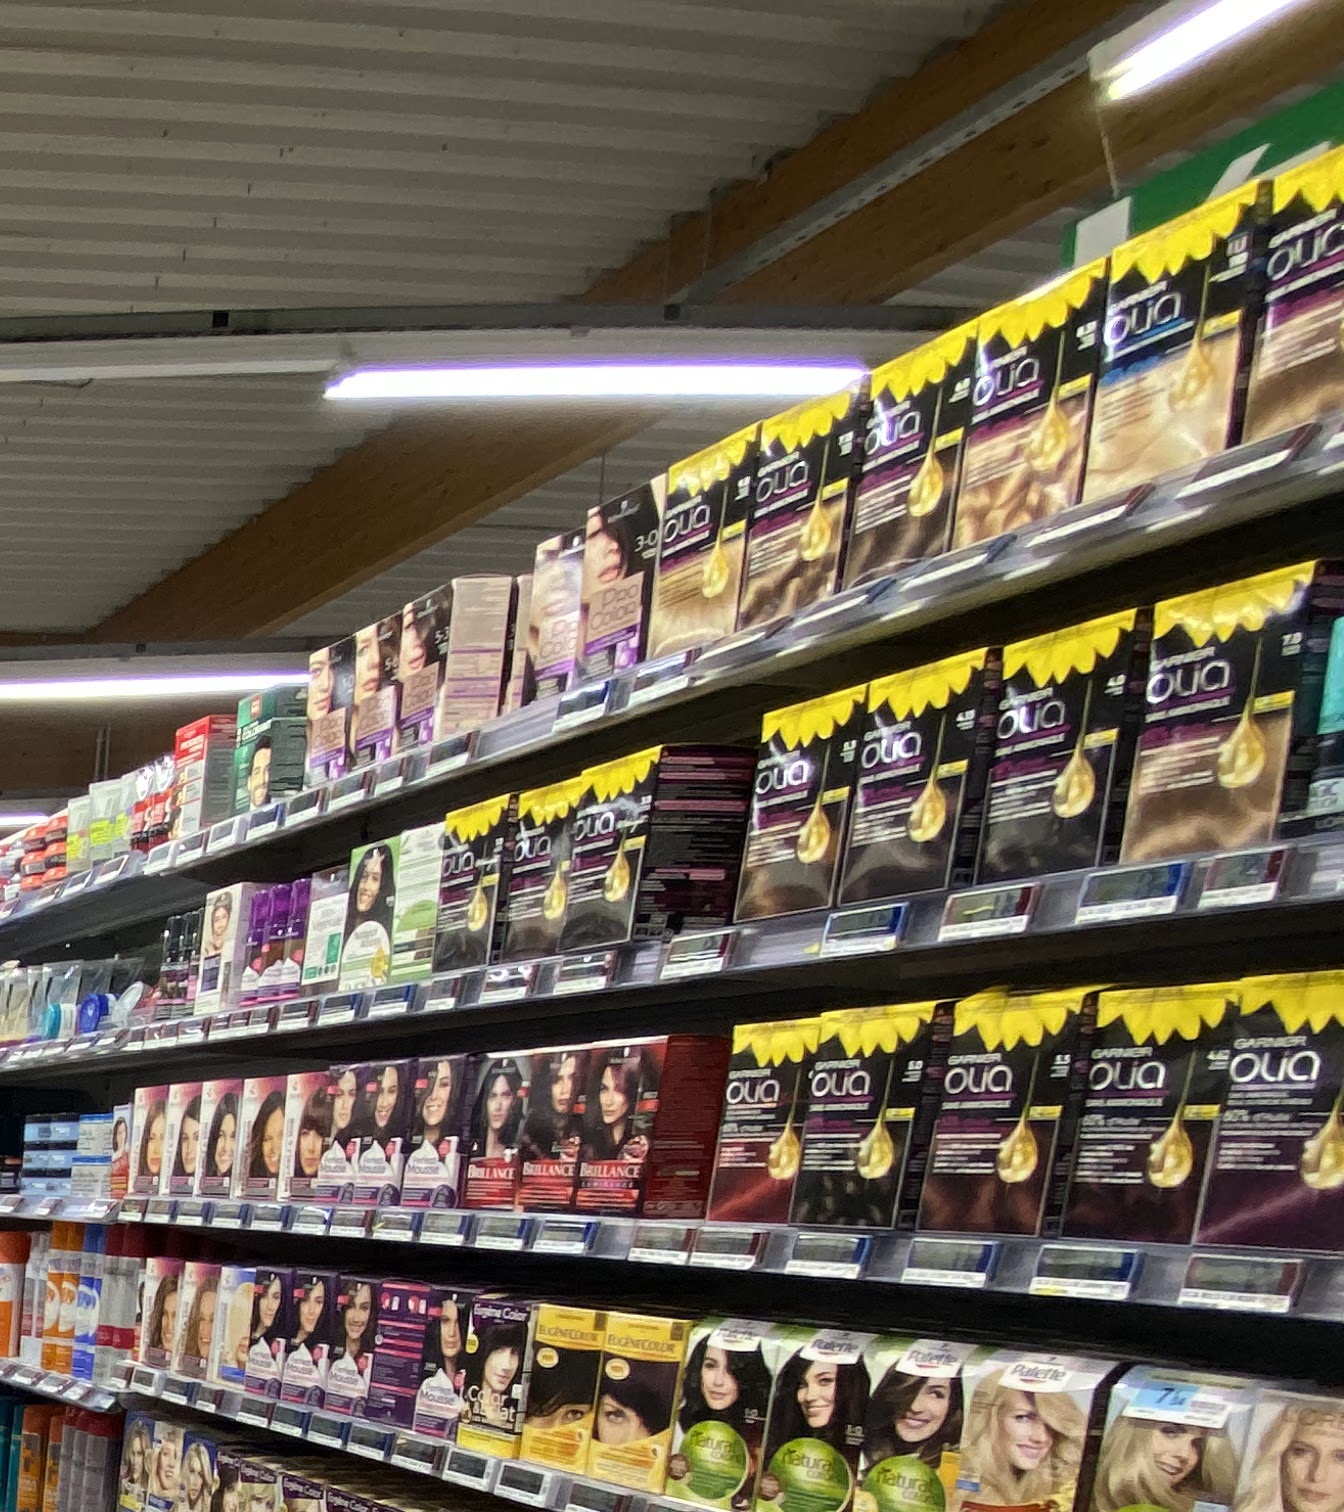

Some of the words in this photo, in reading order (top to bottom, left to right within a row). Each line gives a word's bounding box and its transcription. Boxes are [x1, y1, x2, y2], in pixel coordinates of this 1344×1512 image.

[1233, 1035, 1308, 1050] GARNIER
[467, 1162, 516, 1181] BRILLANCE
[522, 1161, 575, 1178] BRILLANCE
[579, 1161, 642, 1179] BRILLANCE
[502, 1307, 528, 1322] Color
[811, 1336, 859, 1353] Palette
[909, 1349, 958, 1365] Palette
[1011, 1362, 1066, 1381] Palette
